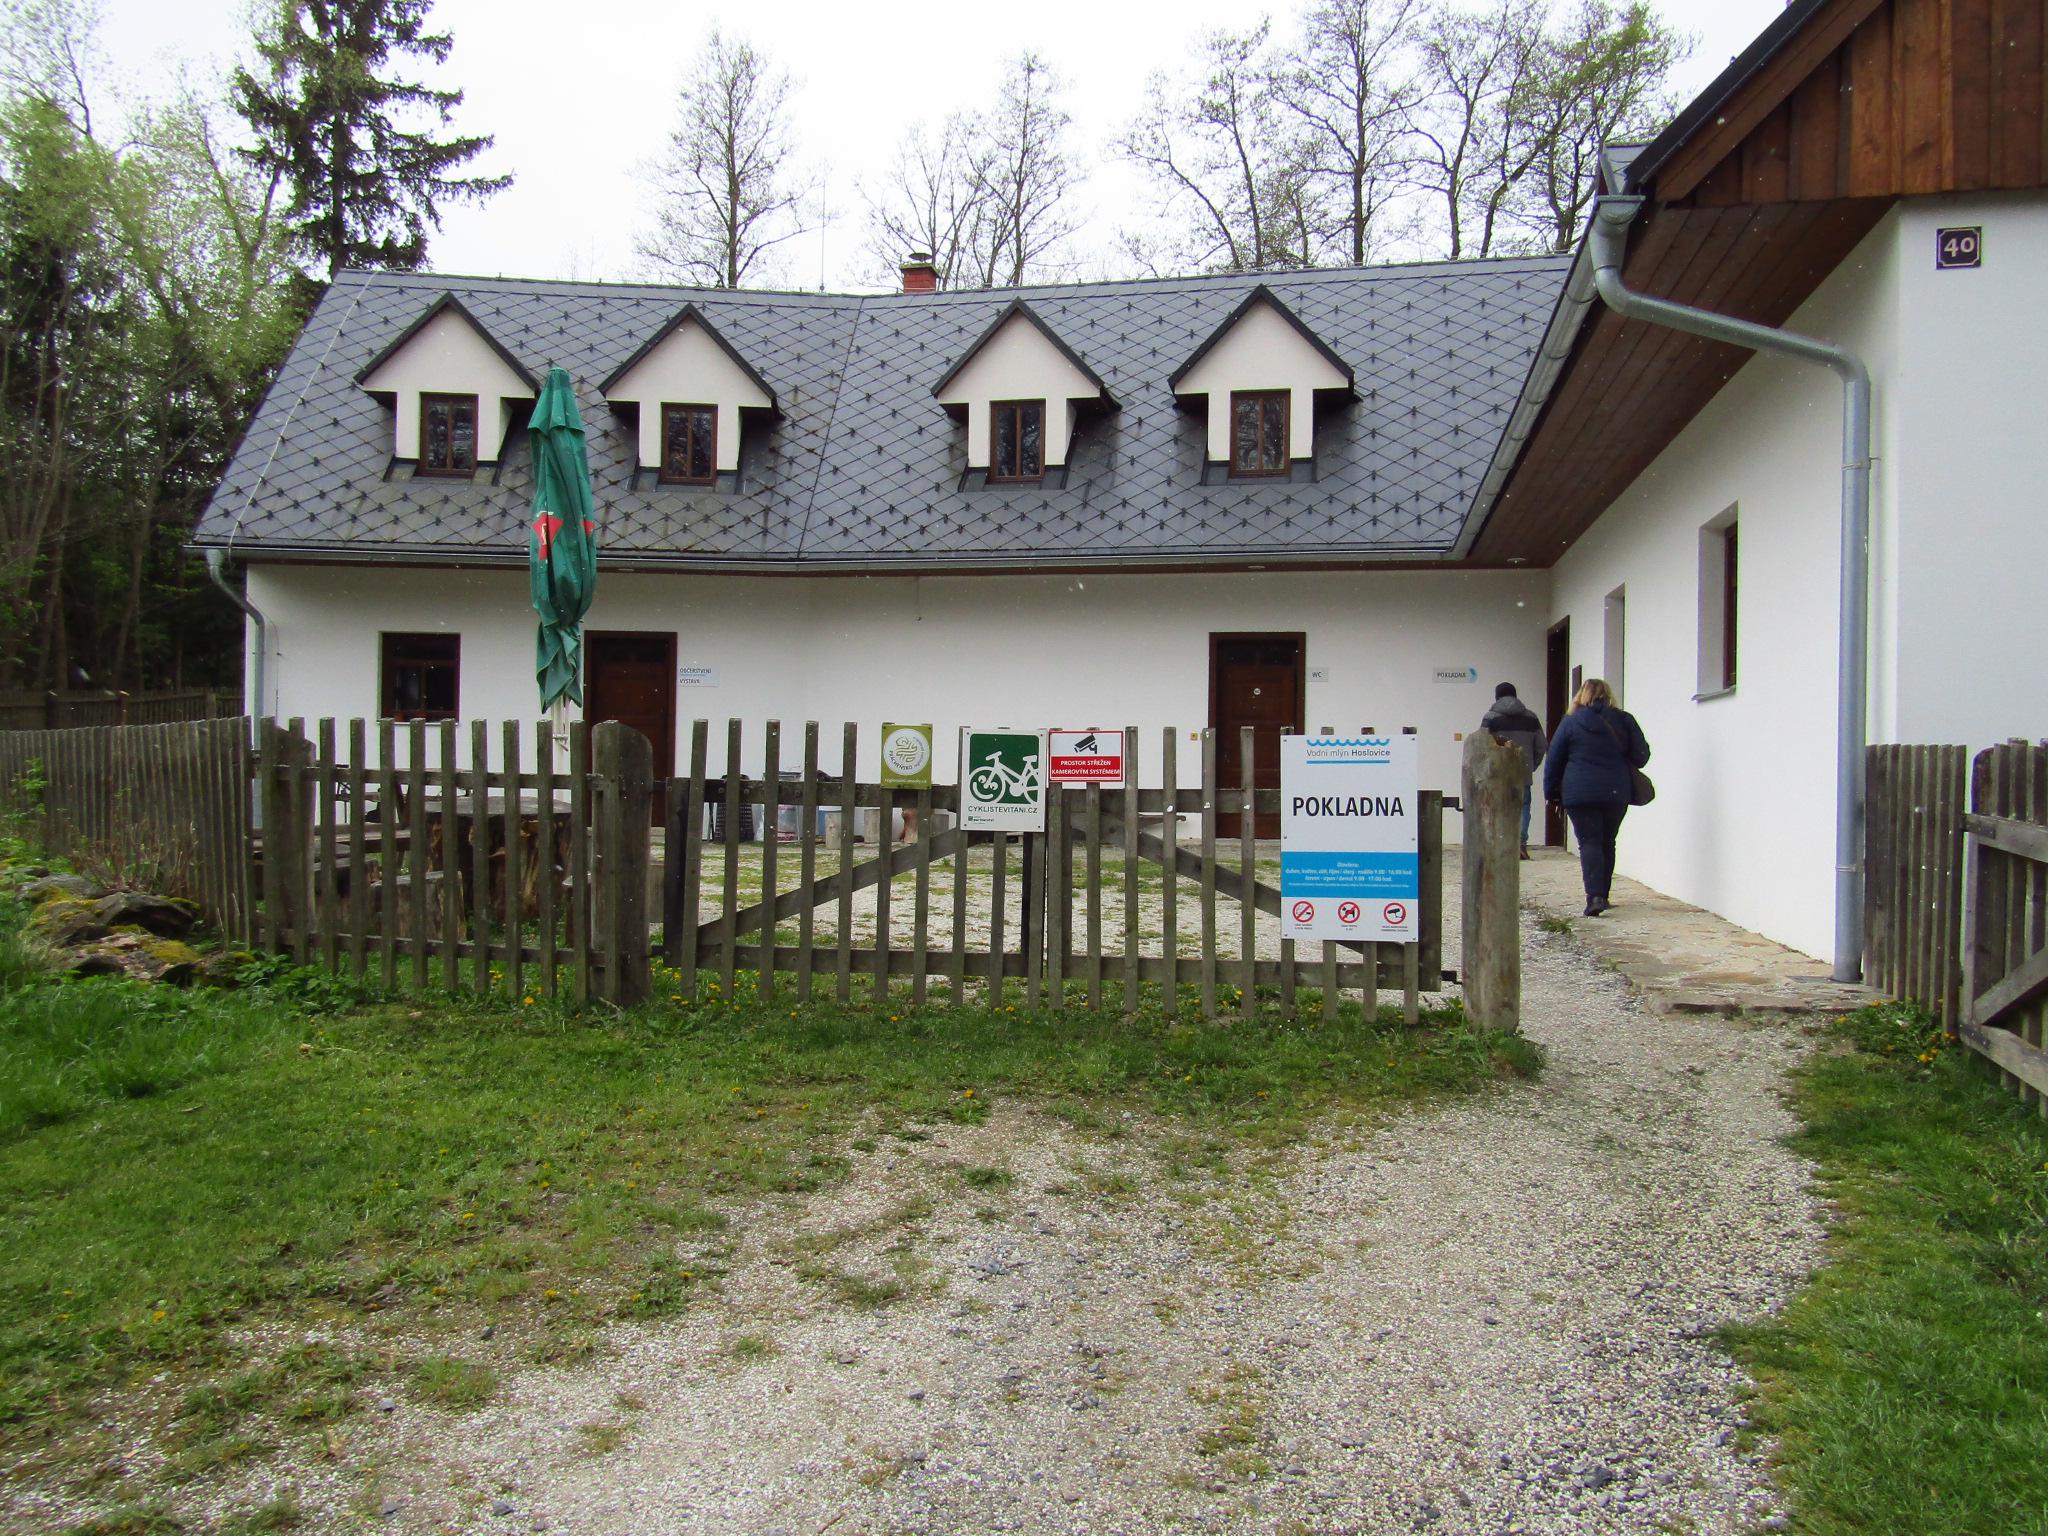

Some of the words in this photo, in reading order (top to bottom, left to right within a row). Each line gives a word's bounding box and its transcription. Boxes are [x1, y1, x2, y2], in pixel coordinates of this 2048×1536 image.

[1944, 237, 1975, 257] 40
[1306, 749, 1328, 757] Vodní
[1330, 749, 1349, 758] mlýn
[1351, 749, 1391, 757] Hoslovice
[967, 805, 1038, 814] CYKLISTEVITANI.CZ
[1293, 797, 1404, 816] POKLADNA
